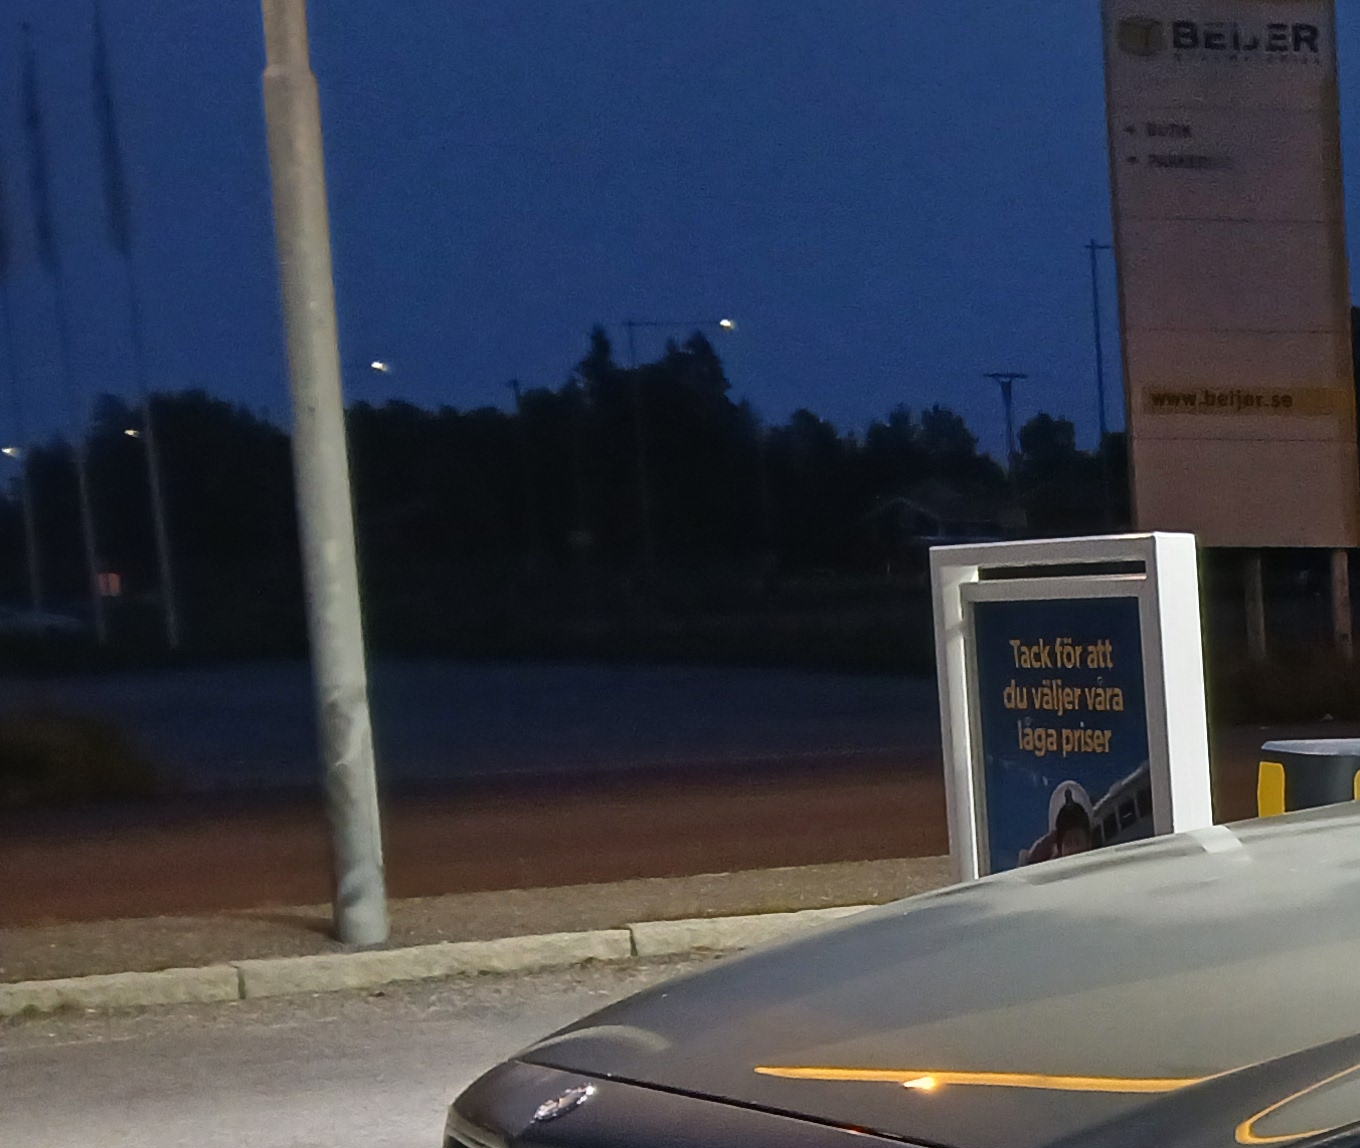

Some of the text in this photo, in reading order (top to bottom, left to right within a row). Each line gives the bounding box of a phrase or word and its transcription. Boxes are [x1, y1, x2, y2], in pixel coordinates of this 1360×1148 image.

[1172, 20, 1320, 53] BEIJER
[1009, 637, 1114, 669] Tack för att
[1003, 676, 1124, 716] du väljer våra
[1017, 717, 1112, 758] låga priser
